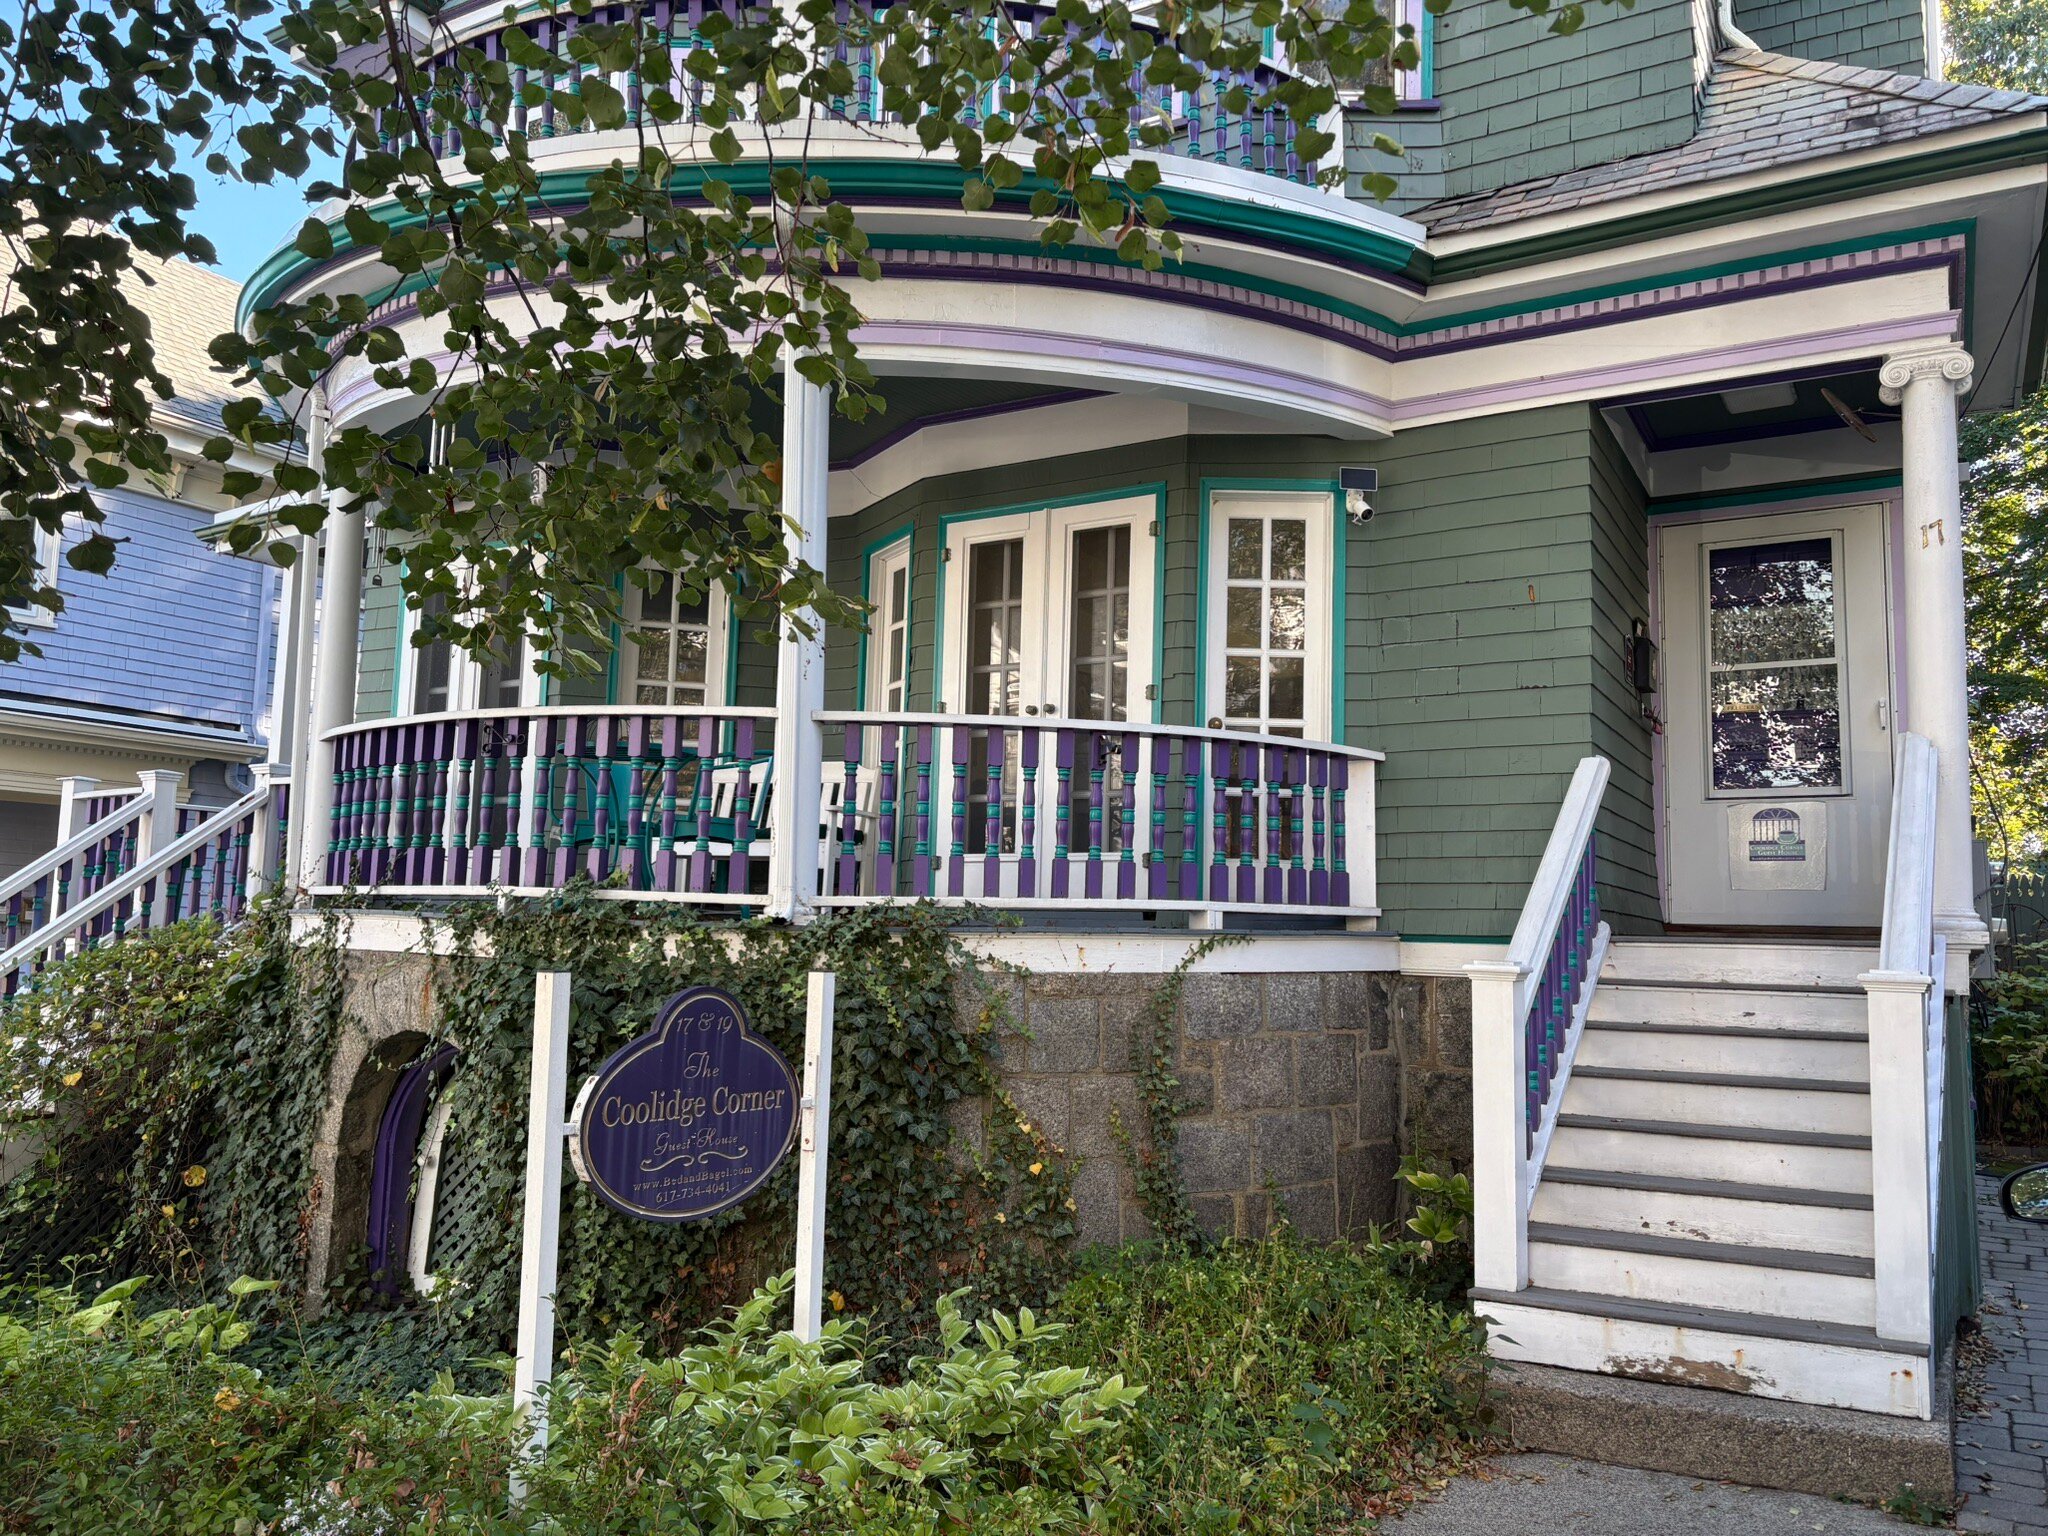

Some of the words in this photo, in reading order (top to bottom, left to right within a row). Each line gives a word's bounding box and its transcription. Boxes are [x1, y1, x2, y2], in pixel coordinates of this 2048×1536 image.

[1920, 519, 1944, 549] 17
[677, 1017, 694, 1034] 17
[698, 1012, 715, 1031] &
[717, 1015, 733, 1034] 19
[684, 1051, 720, 1079] The
[602, 1089, 706, 1127] Coolidge
[712, 1086, 785, 1116] Corner
[653, 1132, 690, 1156] Guest
[696, 1128, 738, 1148] House
[633, 1166, 752, 1191] www.BedandBagel.com
[656, 1182, 730, 1203] 617-734-4041
